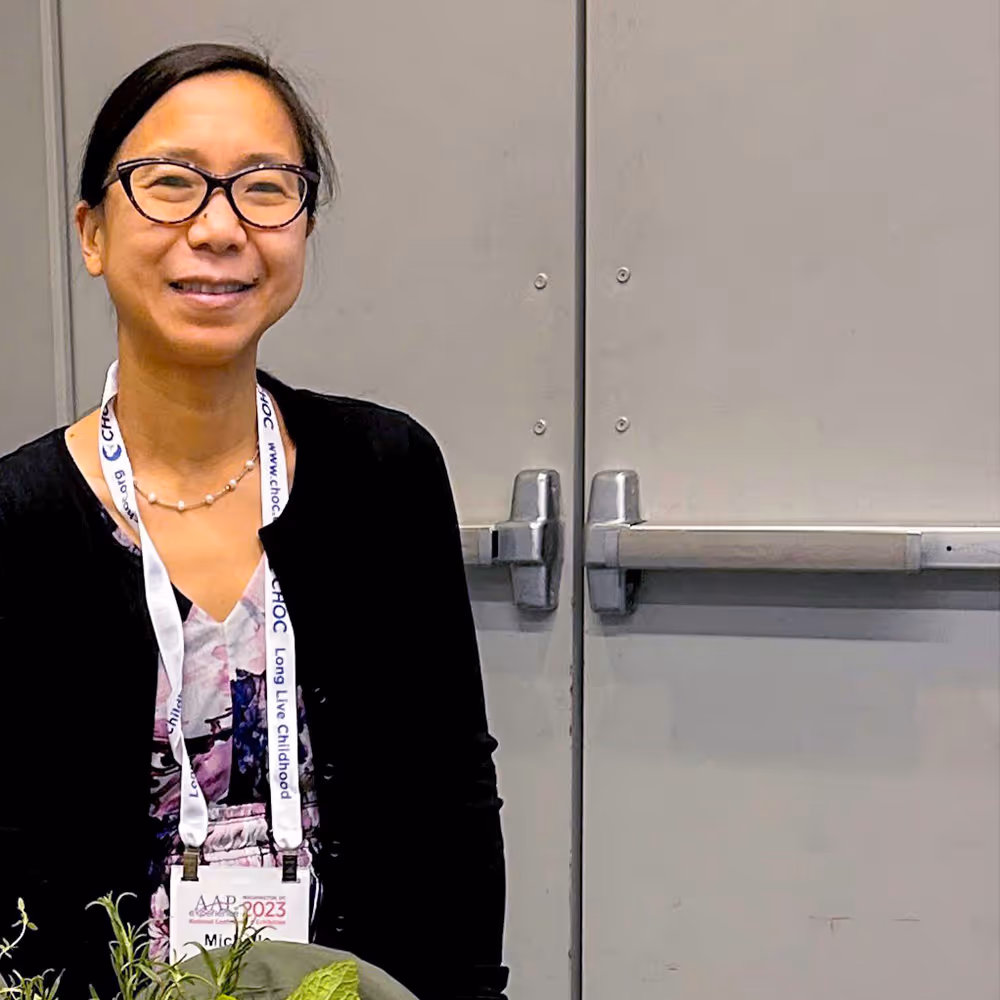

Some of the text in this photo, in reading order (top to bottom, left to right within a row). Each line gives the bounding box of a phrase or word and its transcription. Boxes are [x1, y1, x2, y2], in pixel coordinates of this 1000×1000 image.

[258, 389, 274, 430] HOC
[274, 648, 286, 684] Long
[276, 690, 288, 719] Live
[277, 725, 291, 799] Childhood
[242, 901, 286, 917] 2023
